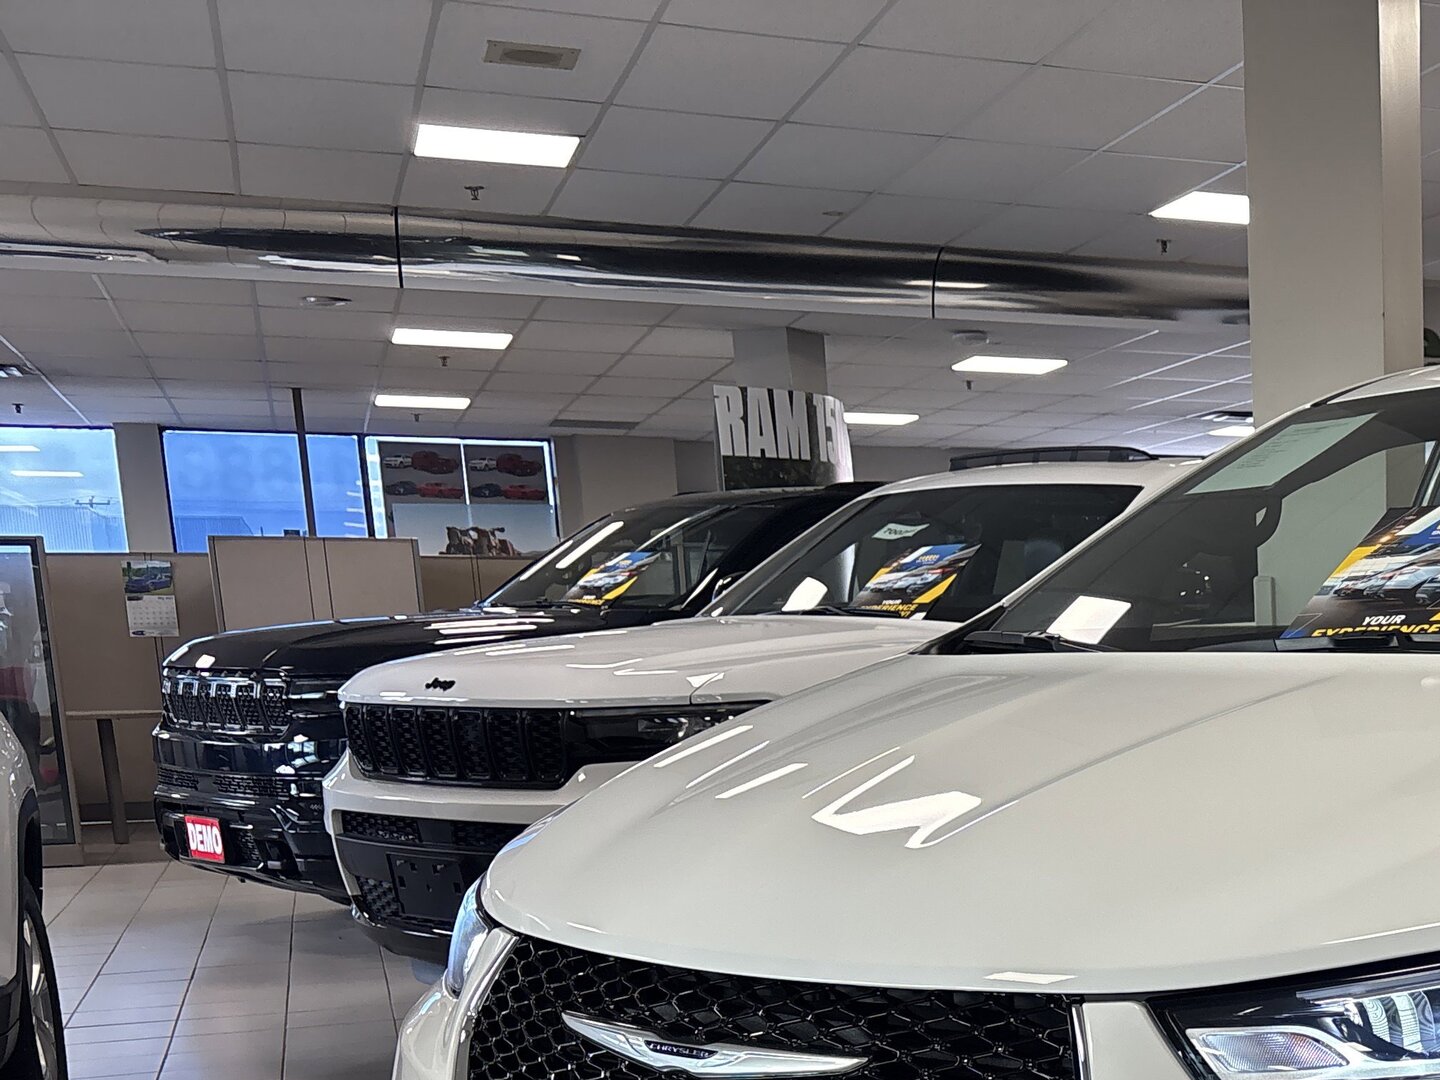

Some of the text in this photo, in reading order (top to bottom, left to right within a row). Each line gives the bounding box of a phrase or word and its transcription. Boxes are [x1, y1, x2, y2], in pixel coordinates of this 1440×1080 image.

[713, 385, 811, 461] RAM
[1361, 615, 1406, 625] YOUR
[187, 822, 223, 855] DEMO
